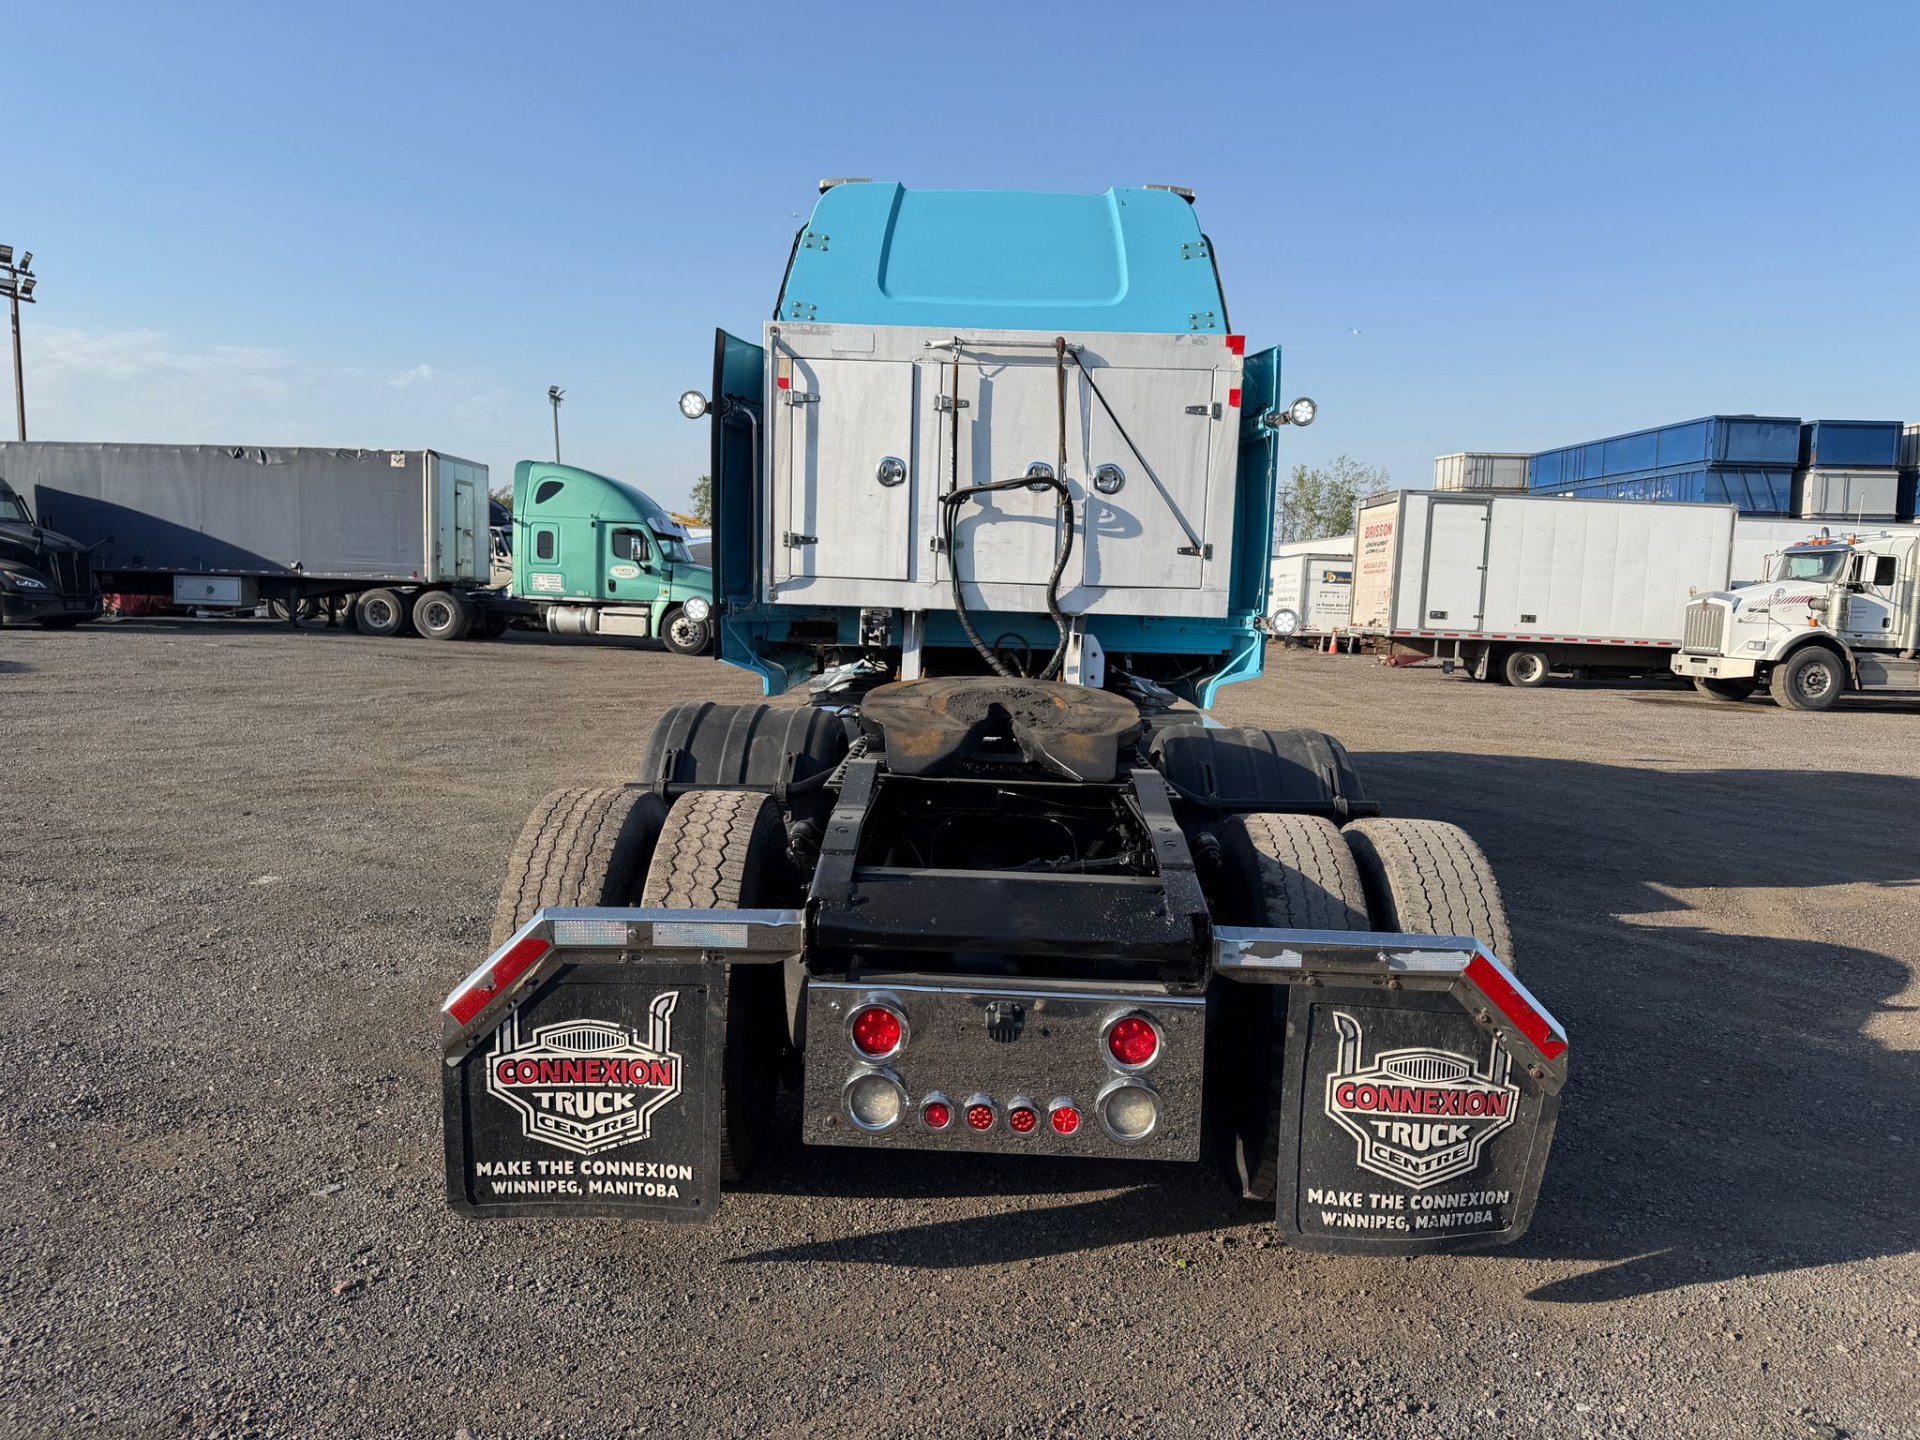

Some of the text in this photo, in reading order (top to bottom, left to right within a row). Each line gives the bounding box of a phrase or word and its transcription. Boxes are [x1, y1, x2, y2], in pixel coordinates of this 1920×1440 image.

[1365, 522, 1393, 539] BRISSON
[497, 1060, 672, 1086] CONNEXION
[532, 1092, 637, 1119] TRUCK
[1336, 1082, 1508, 1116] CONNEXION
[538, 1115, 636, 1139] CENTRE
[1370, 1120, 1472, 1151] TRUCK
[476, 1160, 693, 1180] MAKE THE CONNEXION
[1373, 1144, 1469, 1172] CENTRE
[491, 1180, 680, 1198] WINNIPEG, MANITOBA
[1307, 1188, 1510, 1210] MAKE THE CONNEXION
[1321, 1210, 1493, 1232] WINNIPEG, MANITOBA
